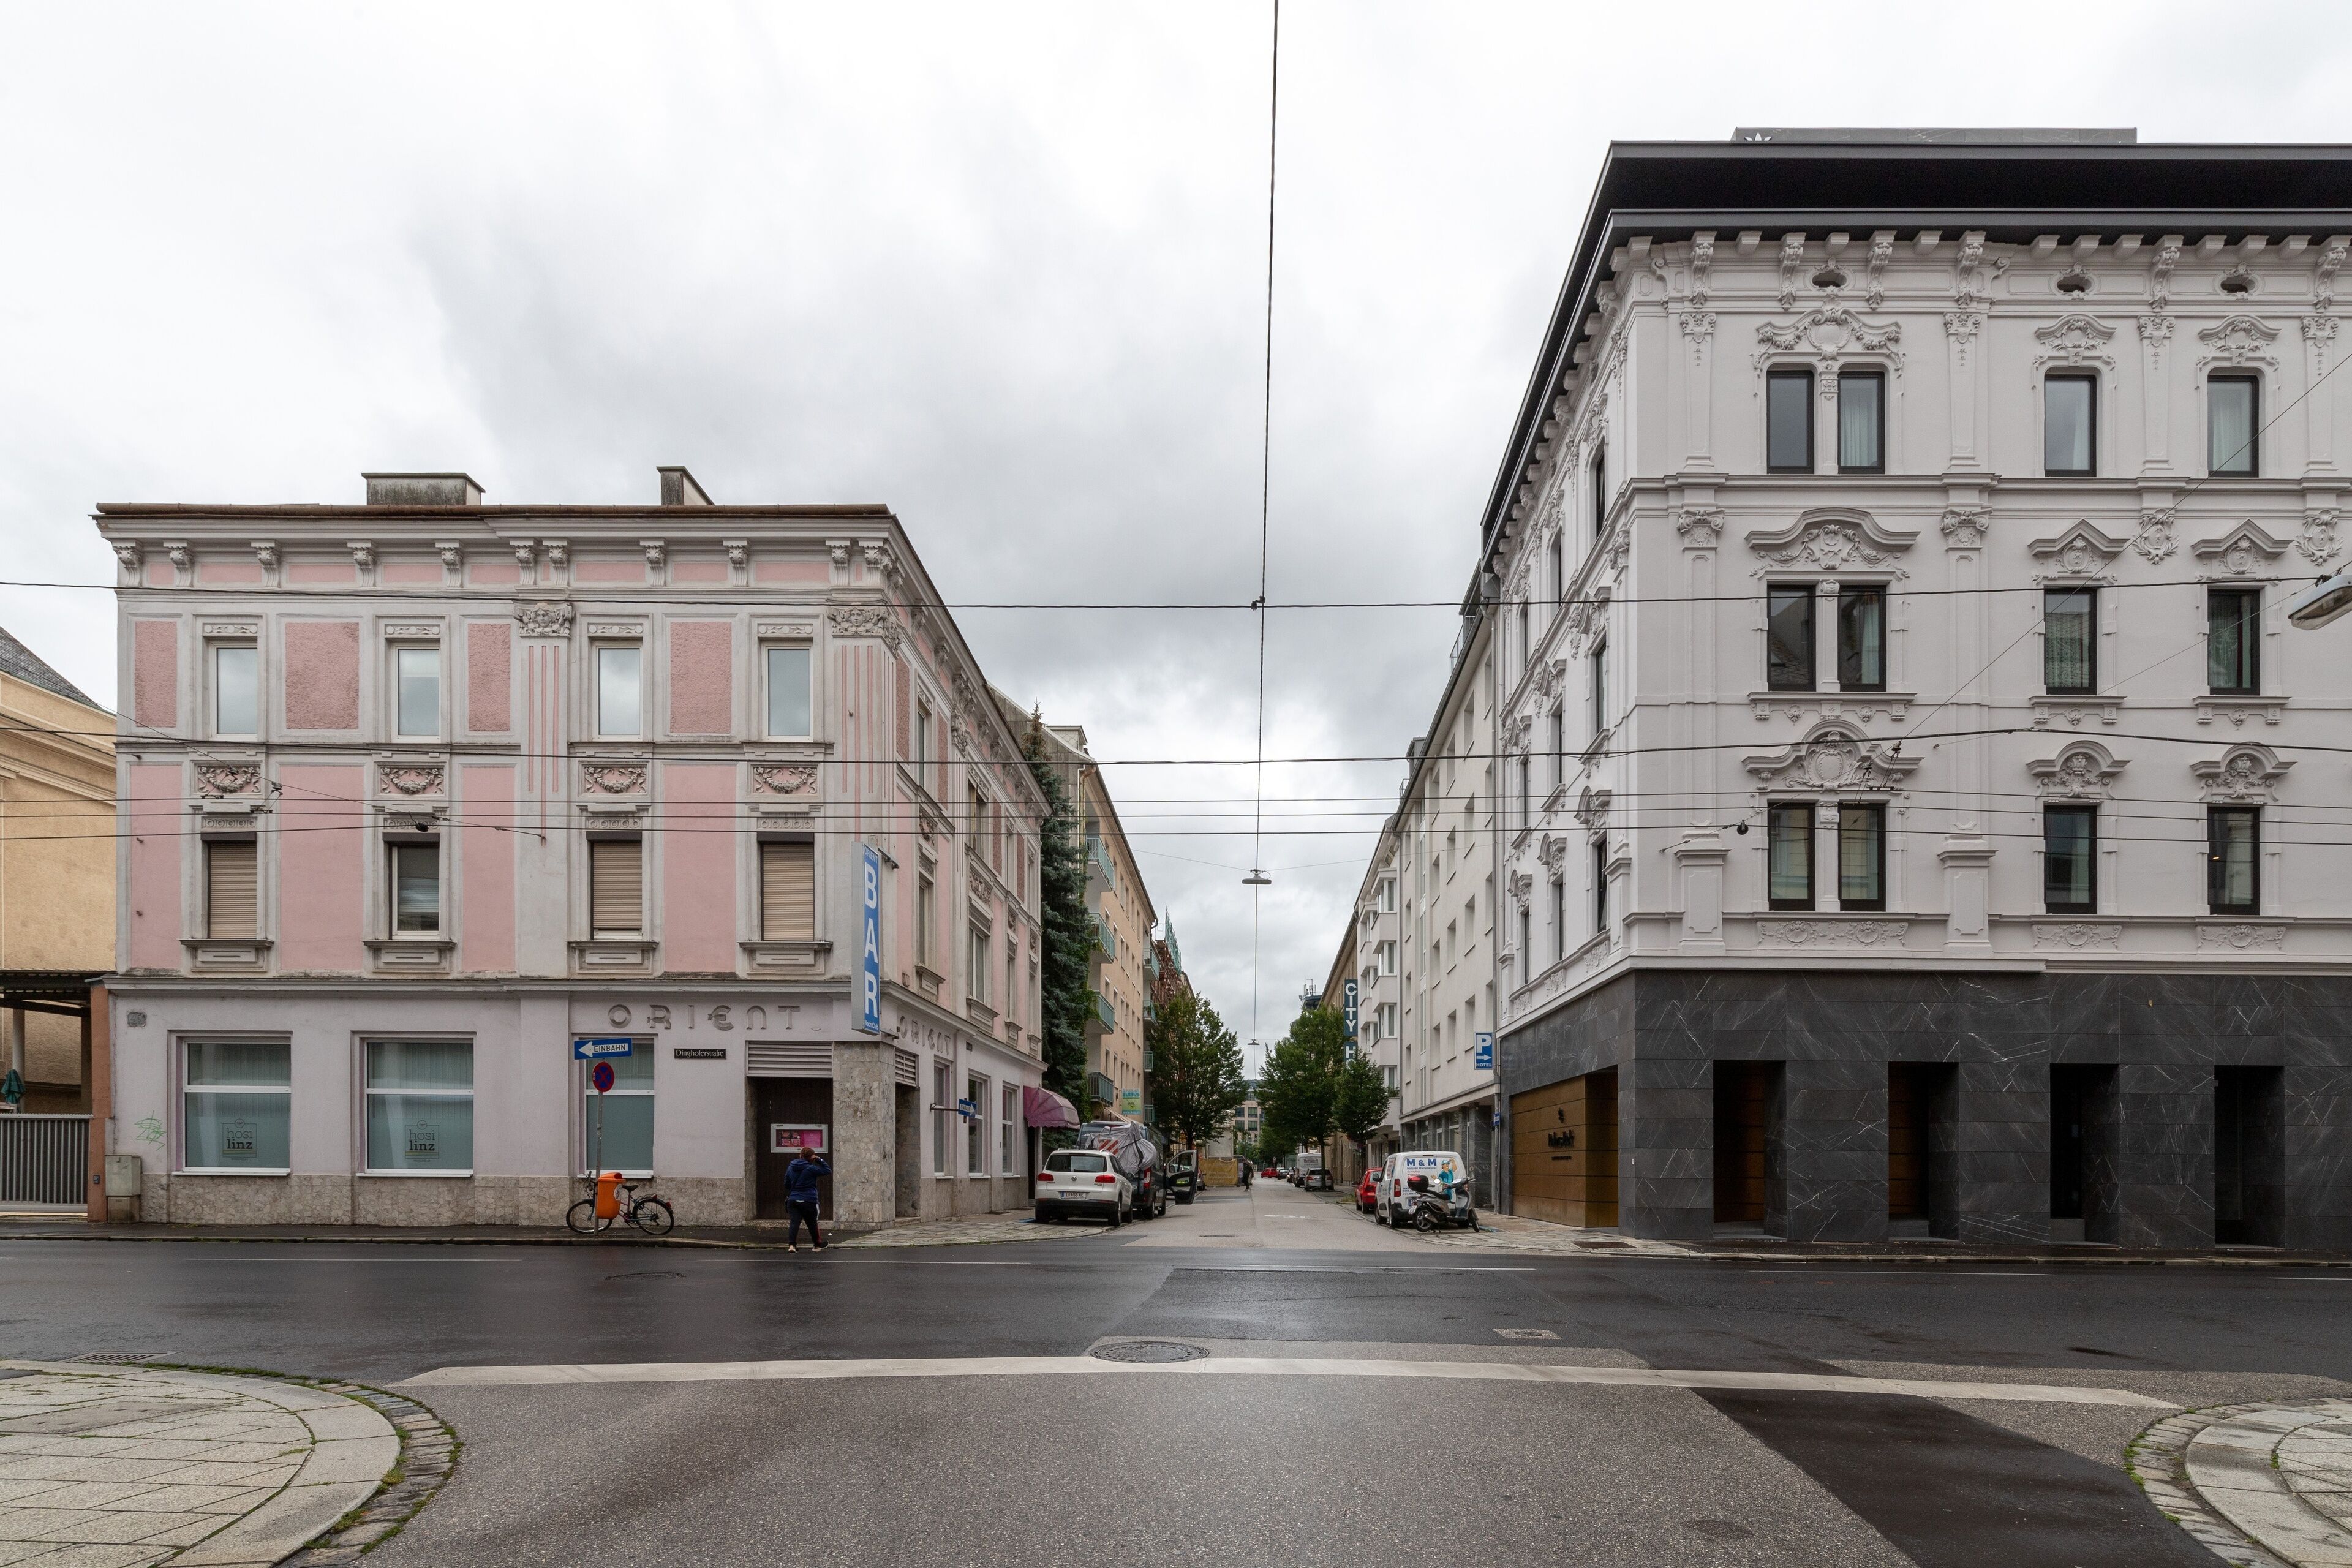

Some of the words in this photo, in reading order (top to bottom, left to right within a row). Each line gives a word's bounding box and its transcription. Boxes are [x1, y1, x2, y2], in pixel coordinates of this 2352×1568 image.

[864, 861, 878, 1018] BAR
[1345, 982, 1357, 1033] CITY
[608, 1004, 801, 1031] ORIENT
[899, 1016, 951, 1055] ORIENT
[594, 1044, 626, 1052] EINBAHN
[1476, 1035, 1492, 1054] P
[676, 1049, 725, 1058] Dinghoferstraße
[226, 1127, 253, 1139] hosi
[409, 1129, 435, 1140] hosi
[227, 1139, 252, 1150] linz
[409, 1140, 435, 1151] linz
